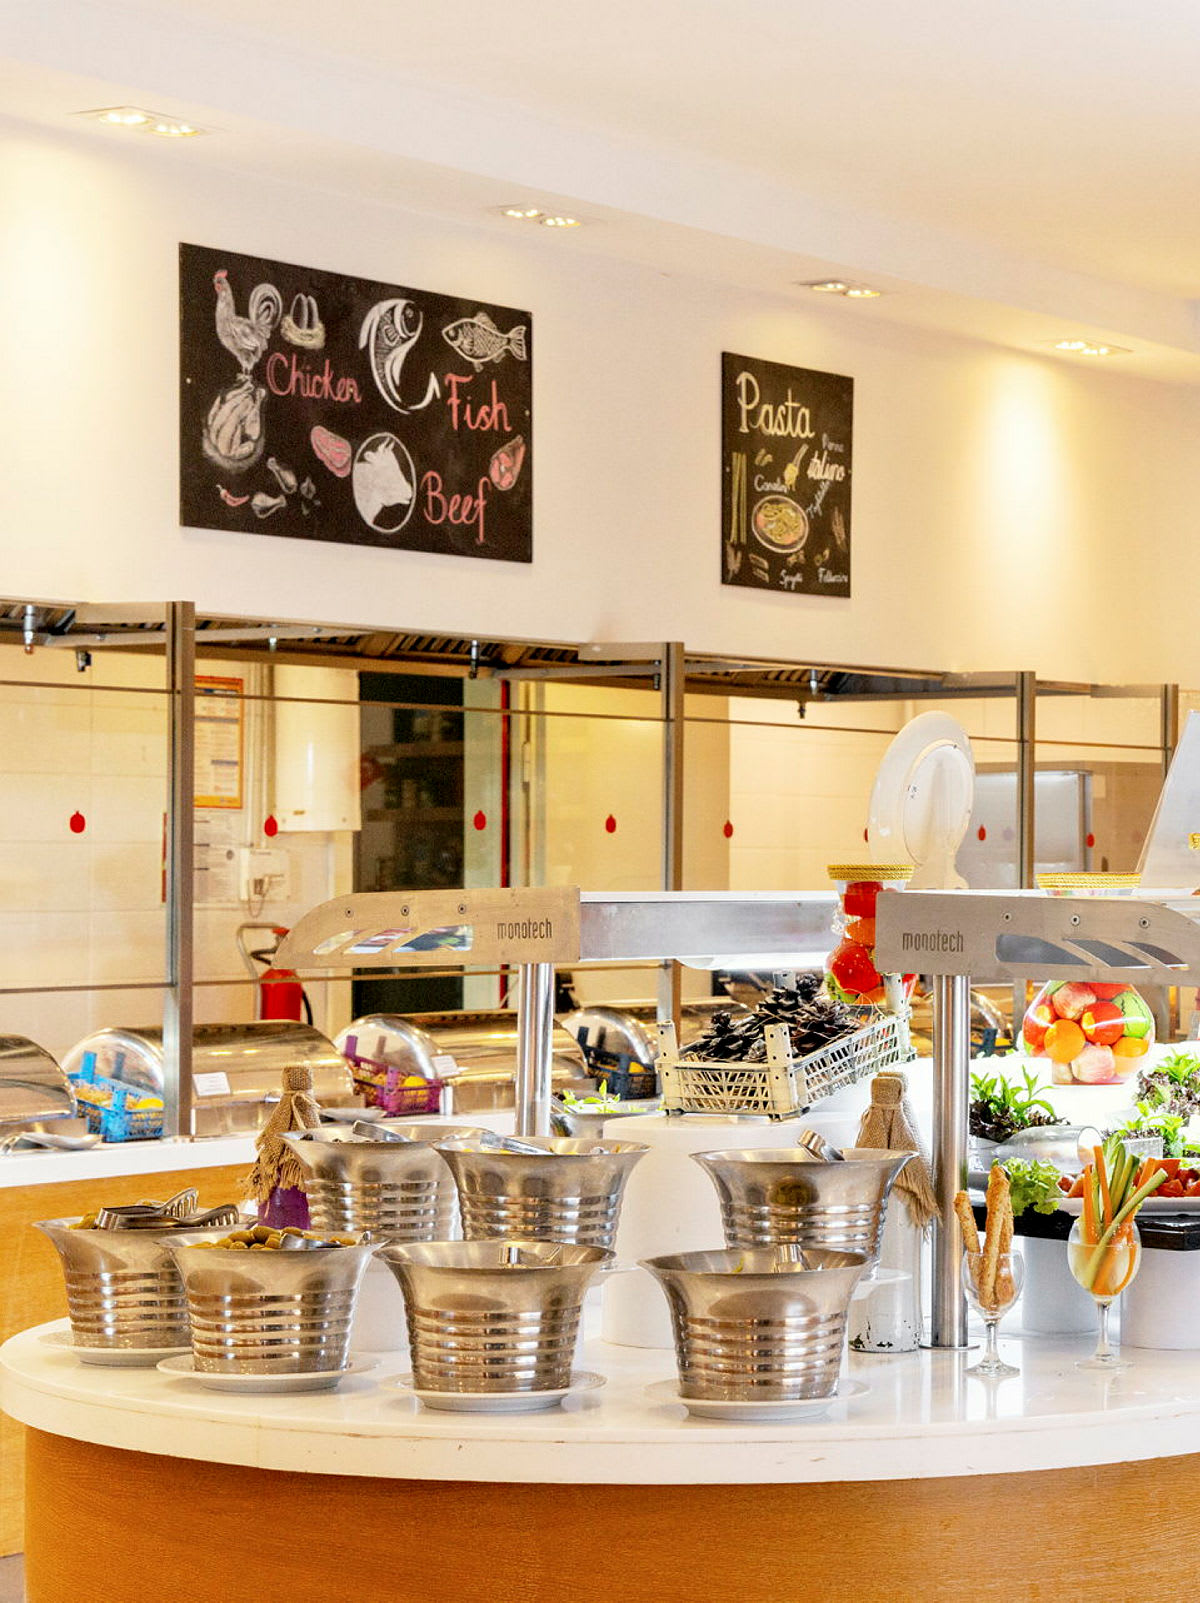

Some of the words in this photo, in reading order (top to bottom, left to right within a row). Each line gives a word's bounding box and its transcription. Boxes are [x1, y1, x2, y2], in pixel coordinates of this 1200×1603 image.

[266, 352, 361, 403] Chicken
[445, 373, 512, 431] Fish
[736, 371, 815, 439] Pasta
[421, 470, 491, 544] Beef
[496, 917, 553, 940] monotech
[902, 929, 964, 953] monotech
